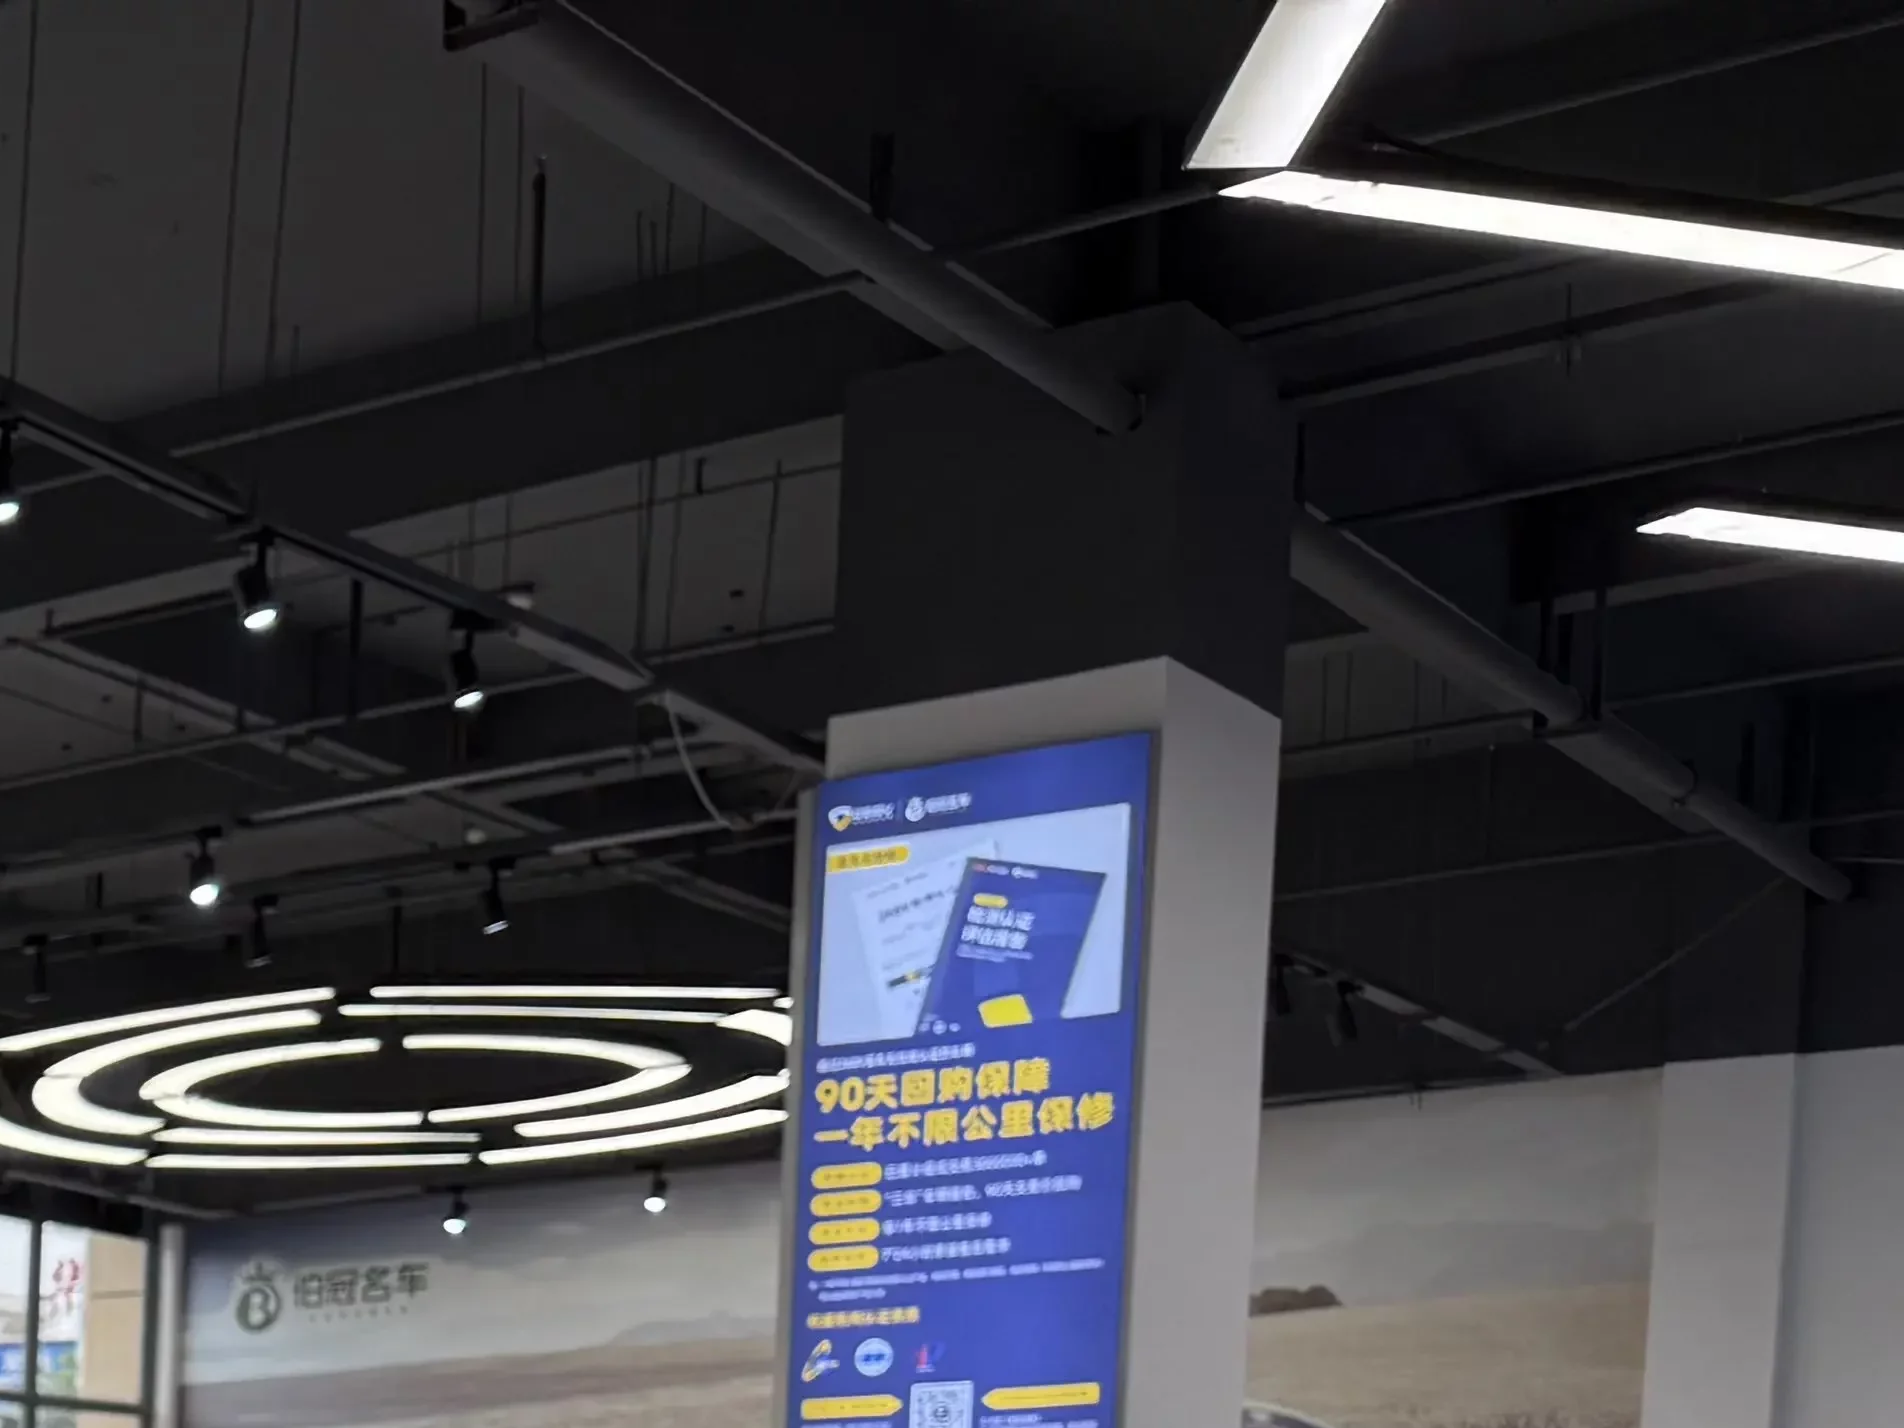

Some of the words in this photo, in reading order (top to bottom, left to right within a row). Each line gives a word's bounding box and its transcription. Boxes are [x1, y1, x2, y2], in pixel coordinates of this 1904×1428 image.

[813, 1091, 1115, 1152] 一年不限公里保修
